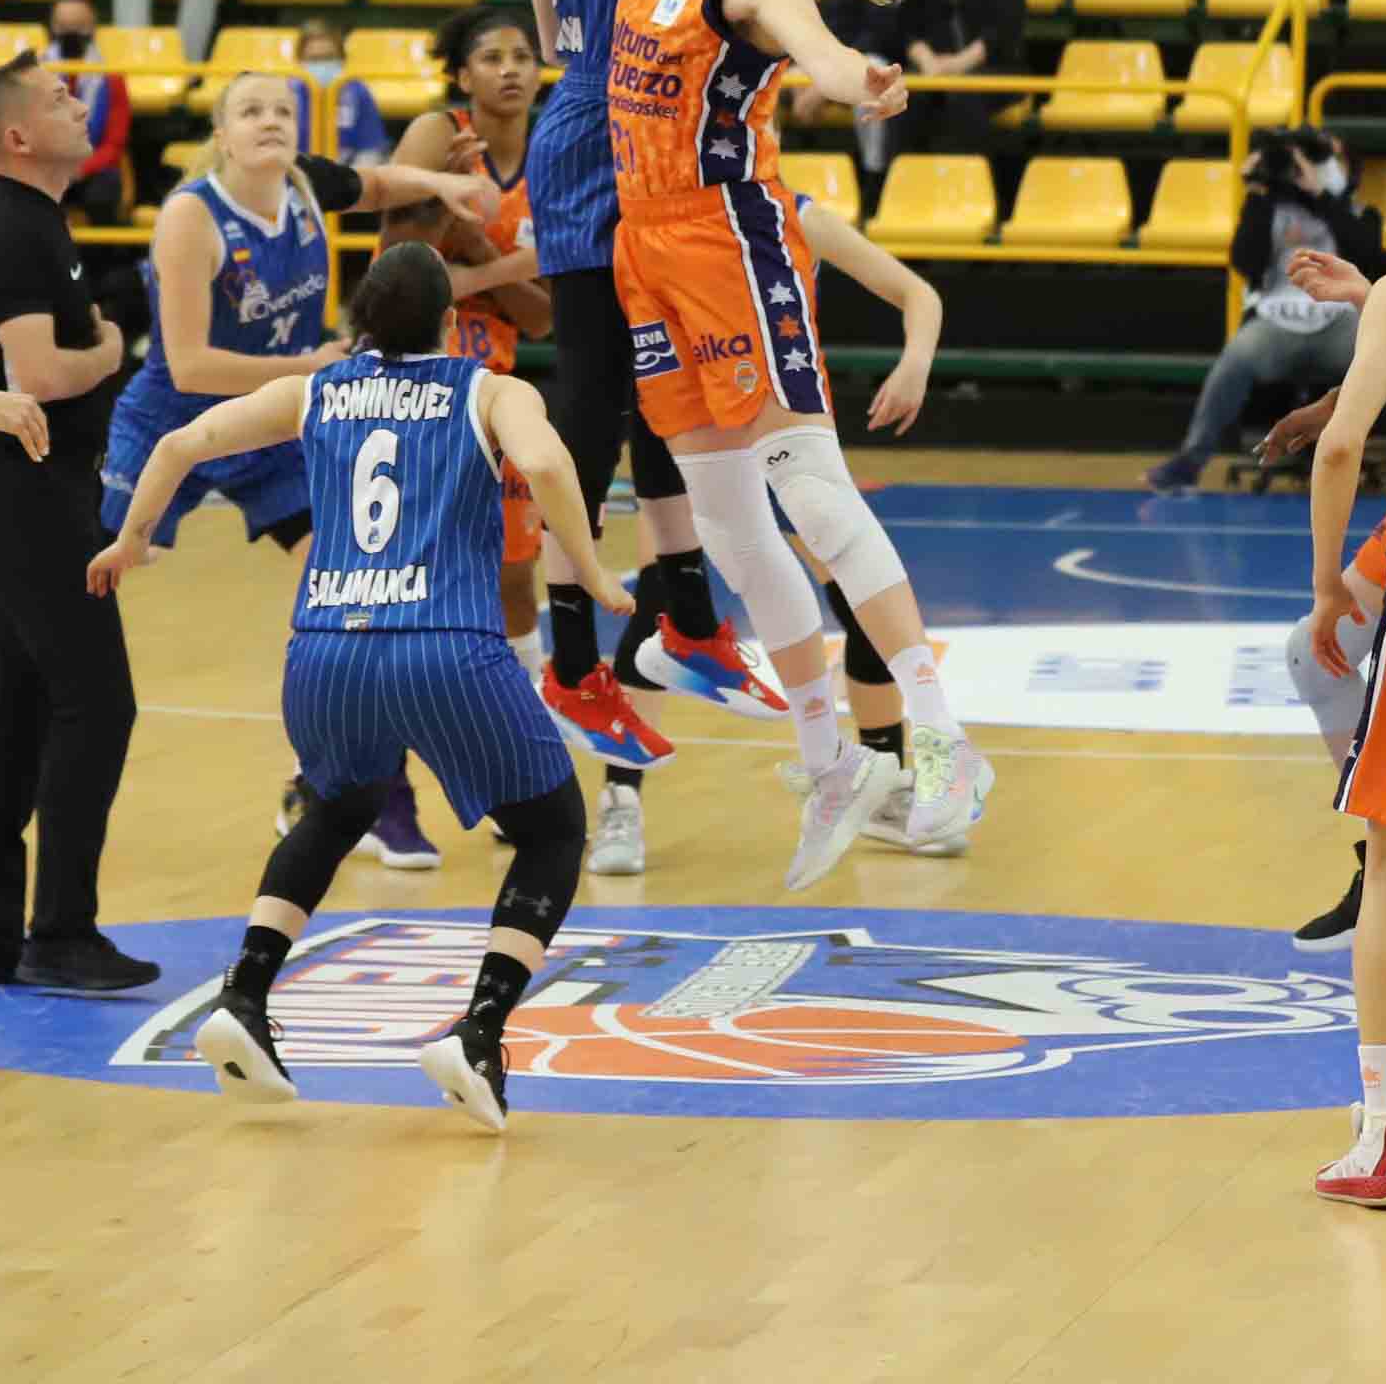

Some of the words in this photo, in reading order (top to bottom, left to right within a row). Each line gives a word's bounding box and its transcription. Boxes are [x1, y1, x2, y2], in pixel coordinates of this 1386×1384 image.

[320, 367, 453, 423] DOMÍNGUEZ
[352, 428, 401, 554] 6
[306, 563, 428, 609] SALAMANCA
